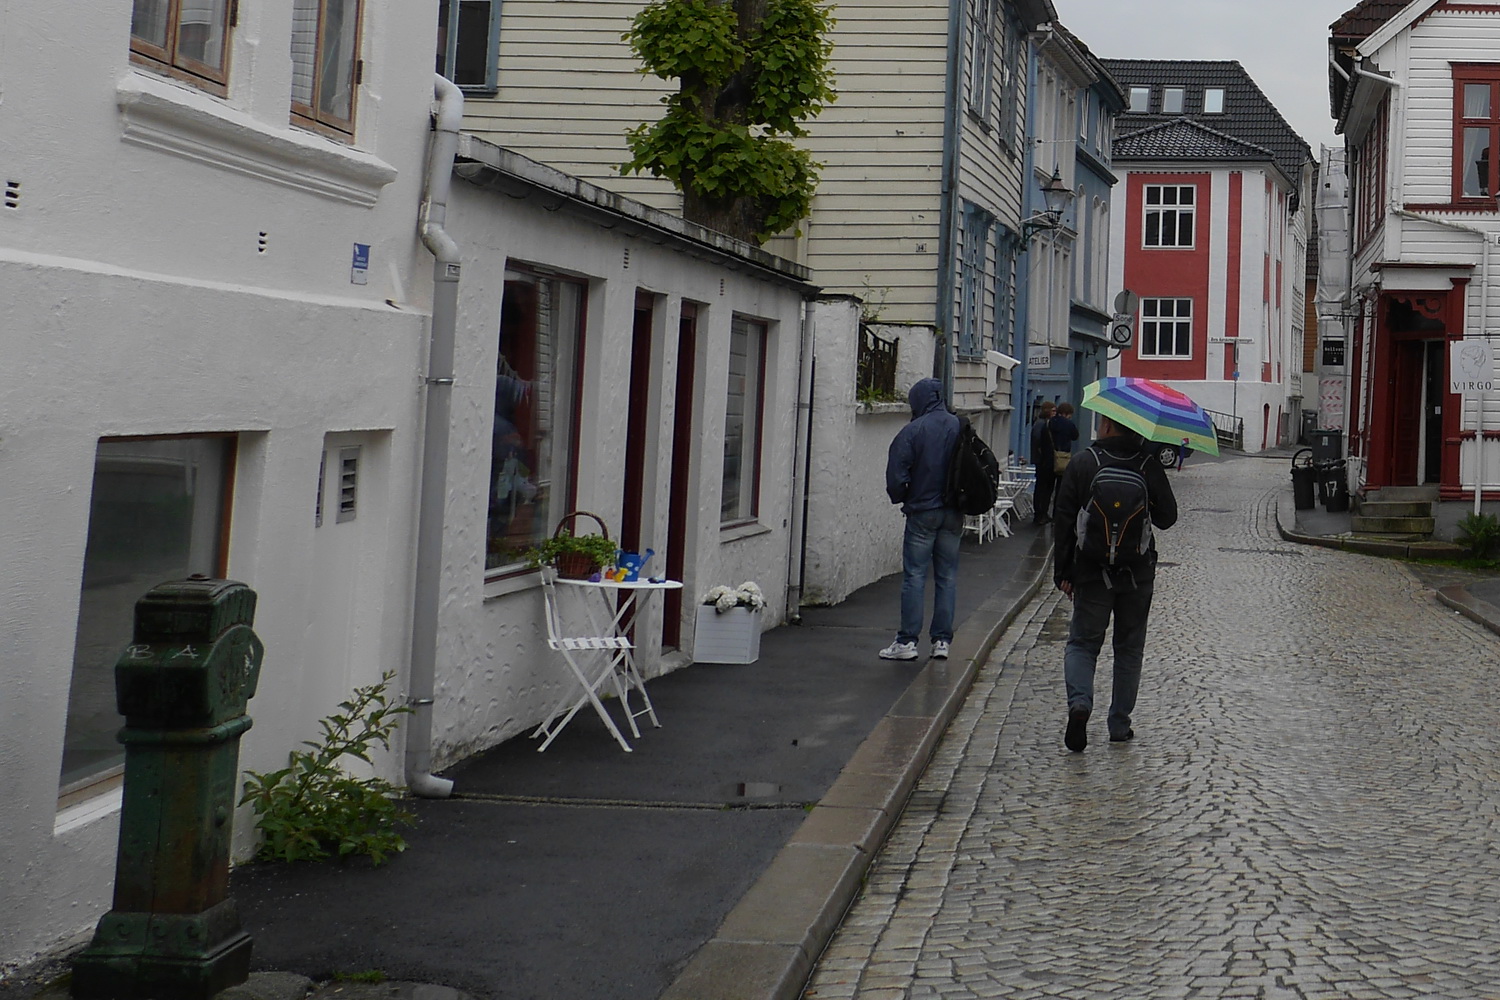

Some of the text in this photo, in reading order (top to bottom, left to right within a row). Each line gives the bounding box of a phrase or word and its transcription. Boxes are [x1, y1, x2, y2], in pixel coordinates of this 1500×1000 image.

[1115, 314, 1133, 322] Sone
[1028, 356, 1049, 365] ATELIER
[1453, 381, 1492, 390] VIRGO
[1325, 480, 1338, 497] 17
